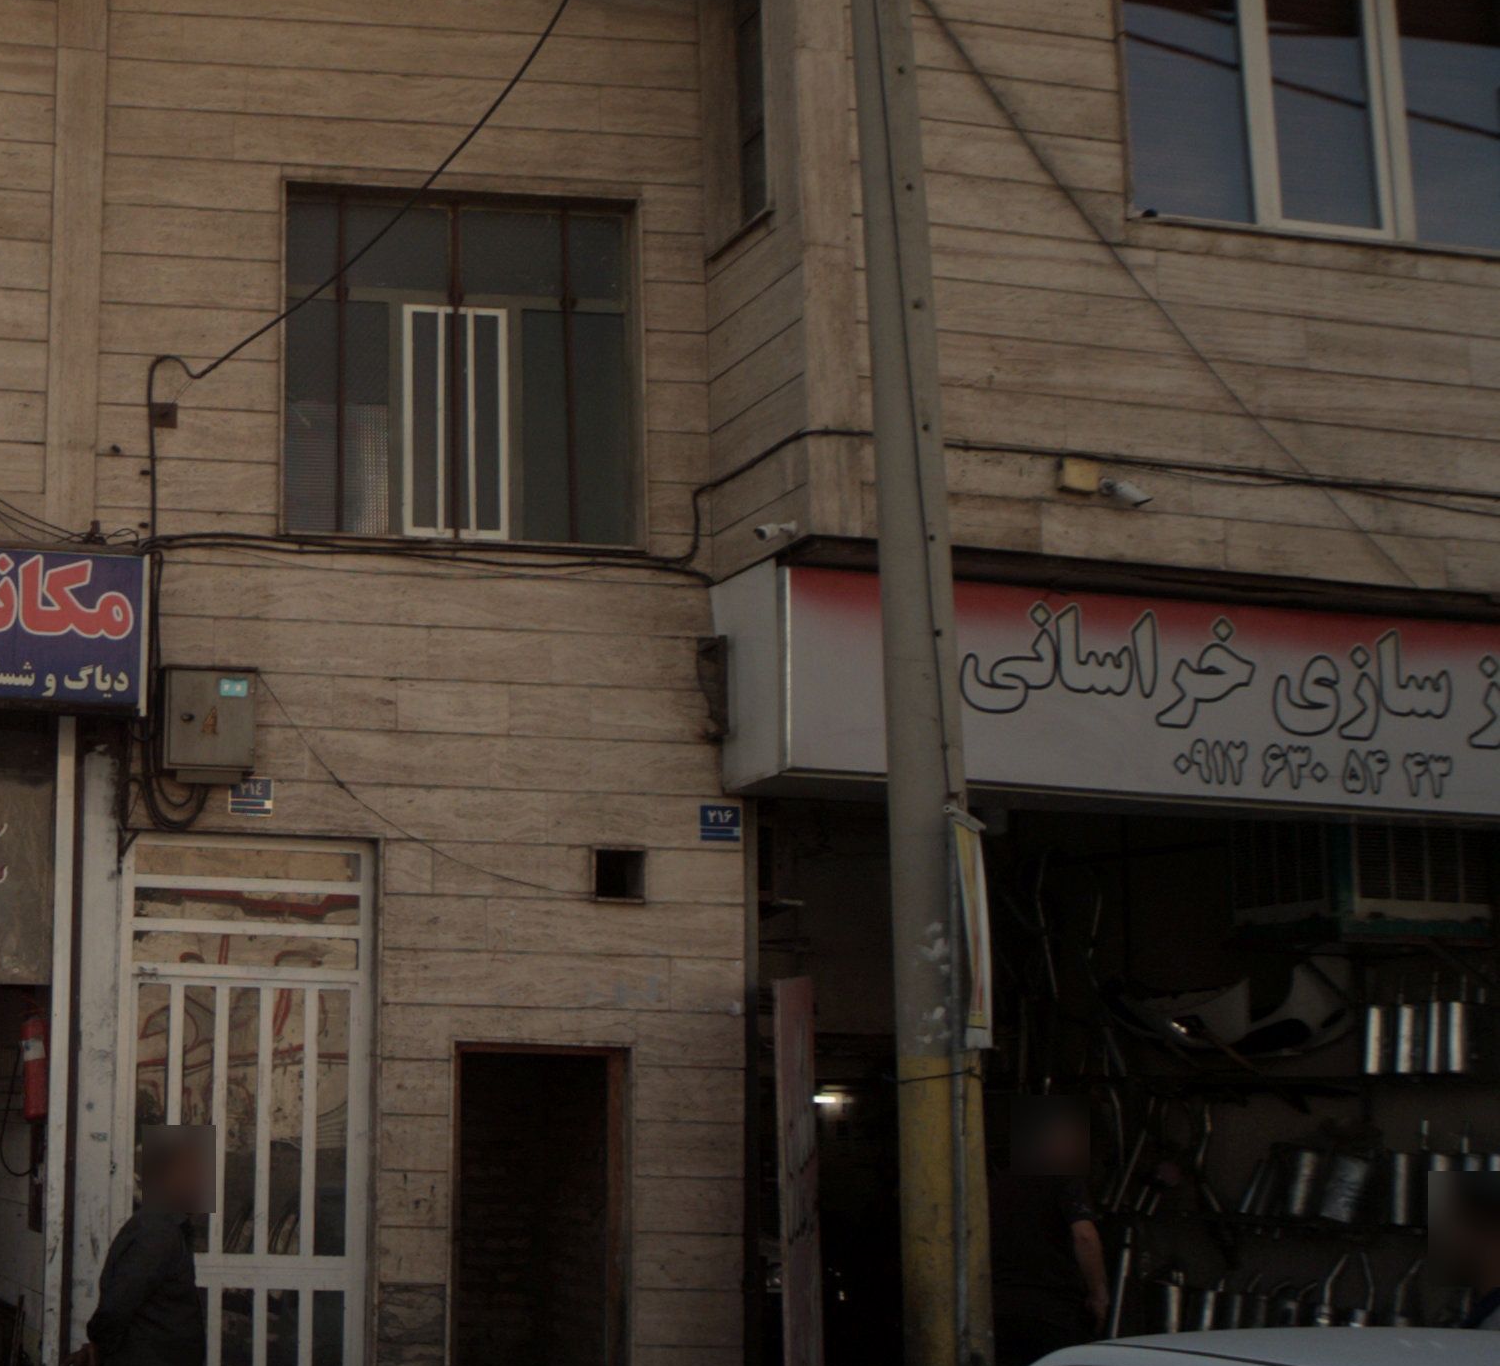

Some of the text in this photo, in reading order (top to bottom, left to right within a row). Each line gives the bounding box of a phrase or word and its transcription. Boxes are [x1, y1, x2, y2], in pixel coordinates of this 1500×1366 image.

[42, 670, 56, 696] و
[64, 664, 129, 698] دیاگ
[961, 602, 1255, 727] خراسانی
[1274, 628, 1451, 740] سازی
[1174, 738, 1248, 785] ۰۹۱۲
[707, 809, 734, 823] ۲۱۶
